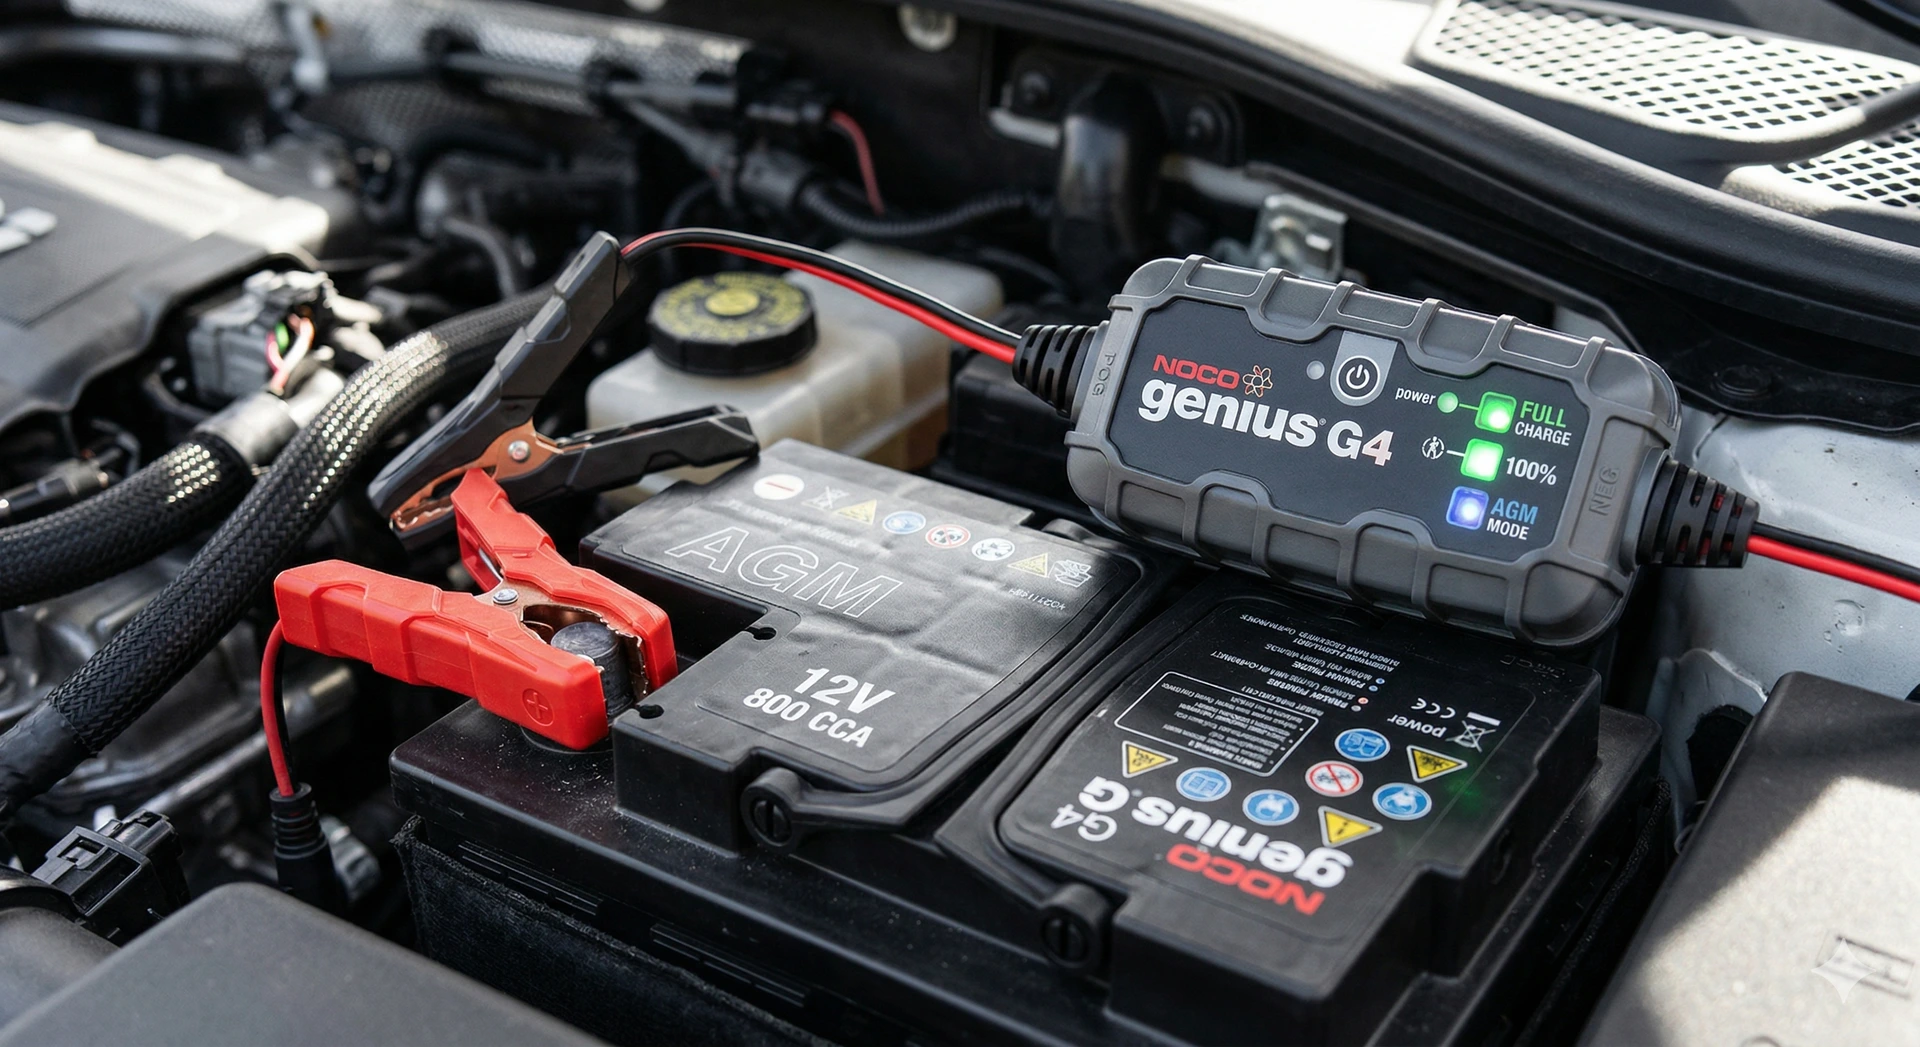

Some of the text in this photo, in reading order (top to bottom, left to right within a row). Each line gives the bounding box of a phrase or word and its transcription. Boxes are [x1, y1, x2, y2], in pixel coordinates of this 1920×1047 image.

[1153, 354, 1240, 390] NOCO
[1395, 387, 1436, 405] power
[1520, 401, 1567, 428] FULL
[1326, 419, 1395, 467] G4
[1515, 421, 1572, 446] CHARGE
[1506, 456, 1557, 485] 100%
[1589, 466, 1619, 516] NEG
[1486, 517, 1530, 540] MODE
[1490, 497, 1539, 525] AGM
[665, 526, 902, 618] AGM
[794, 667, 896, 714] 12V
[743, 687, 874, 748] 800 CCA
[1387, 714, 1447, 738] power
[1050, 803, 1118, 842] G4
[1166, 843, 1326, 915] NOCO
